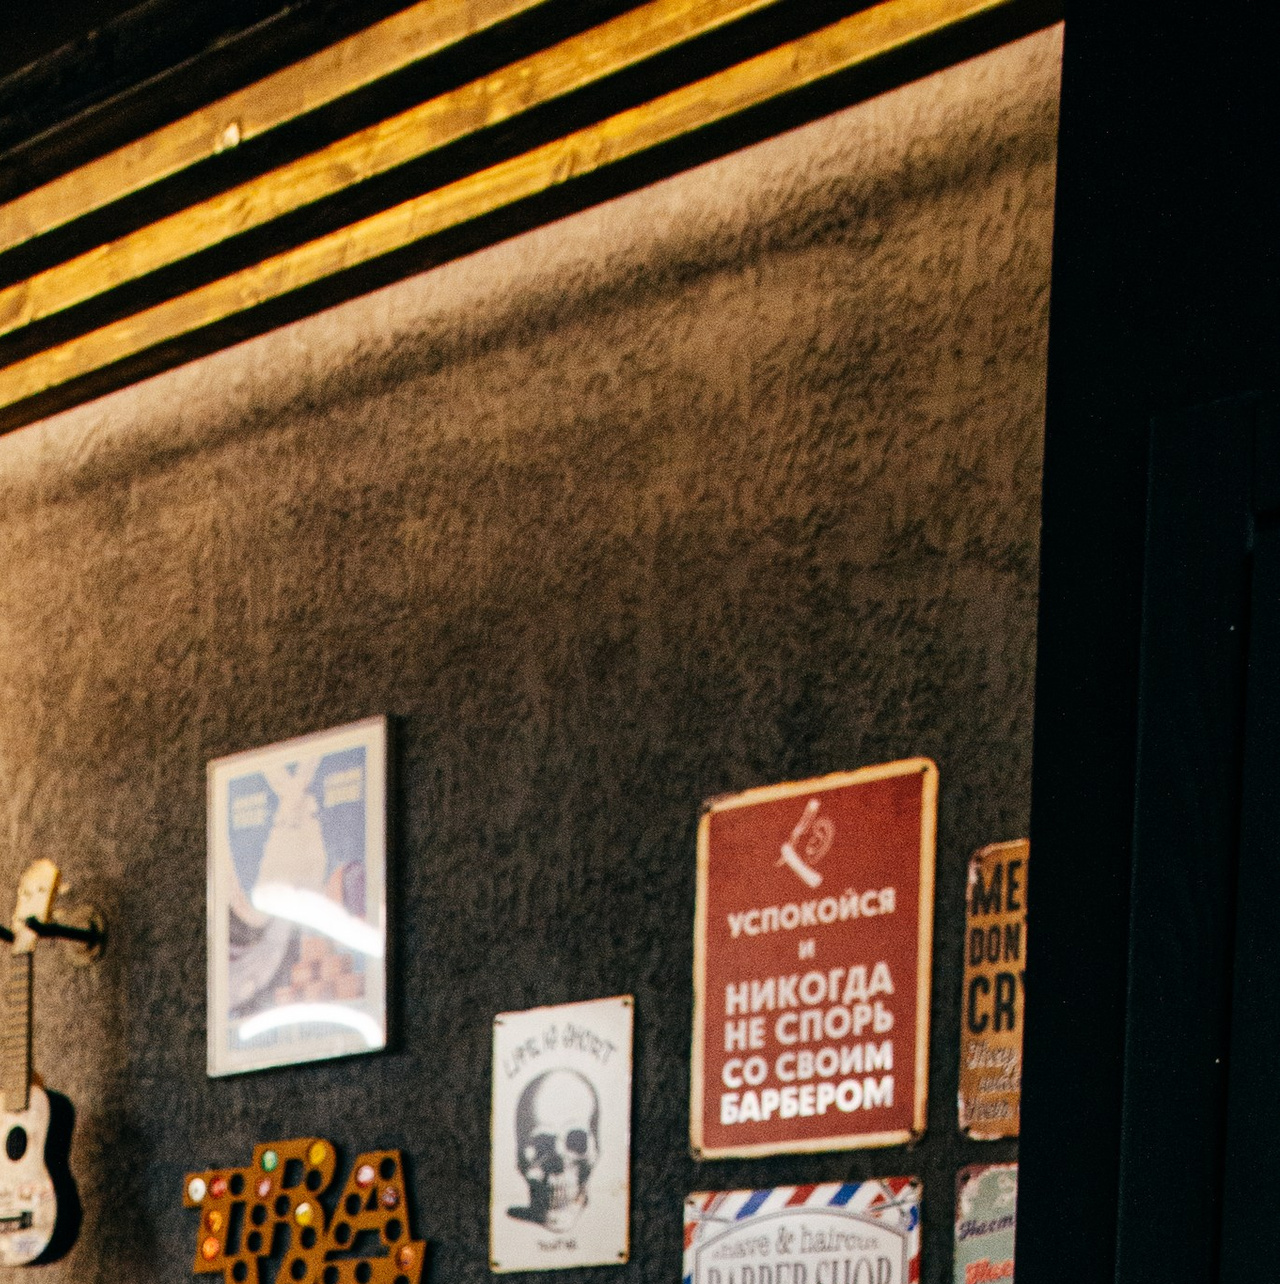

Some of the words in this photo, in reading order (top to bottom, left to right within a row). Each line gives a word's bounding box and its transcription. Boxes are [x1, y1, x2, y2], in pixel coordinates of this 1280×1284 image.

[727, 886, 896, 939] УСПОКОЙСЯ
[970, 859, 1022, 916] ME
[725, 960, 895, 1016] НИКОГДА
[968, 969, 1025, 1034] CR
[724, 1016, 766, 1052] НЕ
[774, 1001, 894, 1045] СПОРЬ
[722, 1055, 769, 1089] СО
[775, 1039, 894, 1083] СВОИМ
[720, 1074, 896, 1125] БАРБЕРОМ
